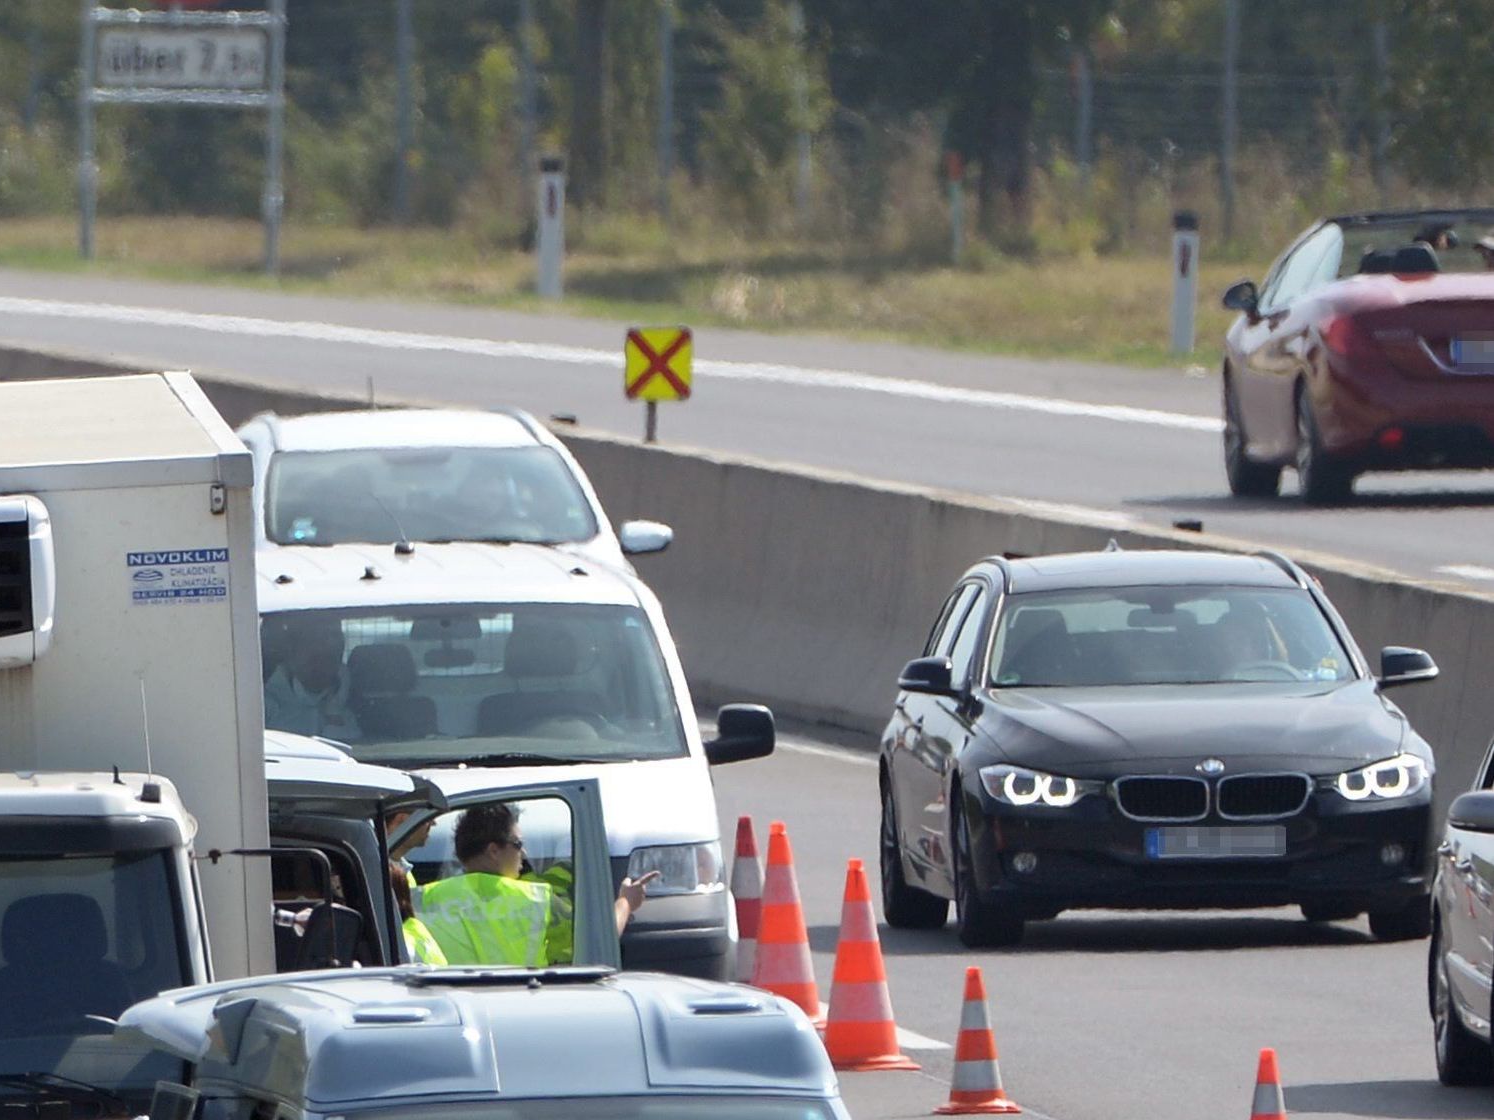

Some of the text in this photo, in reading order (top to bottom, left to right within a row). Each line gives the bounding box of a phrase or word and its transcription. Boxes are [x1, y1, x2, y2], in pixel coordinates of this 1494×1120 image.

[128, 550, 226, 565] NOVOKLIM
[134, 589, 175, 599] SERVIS
[179, 588, 195, 597] 24
